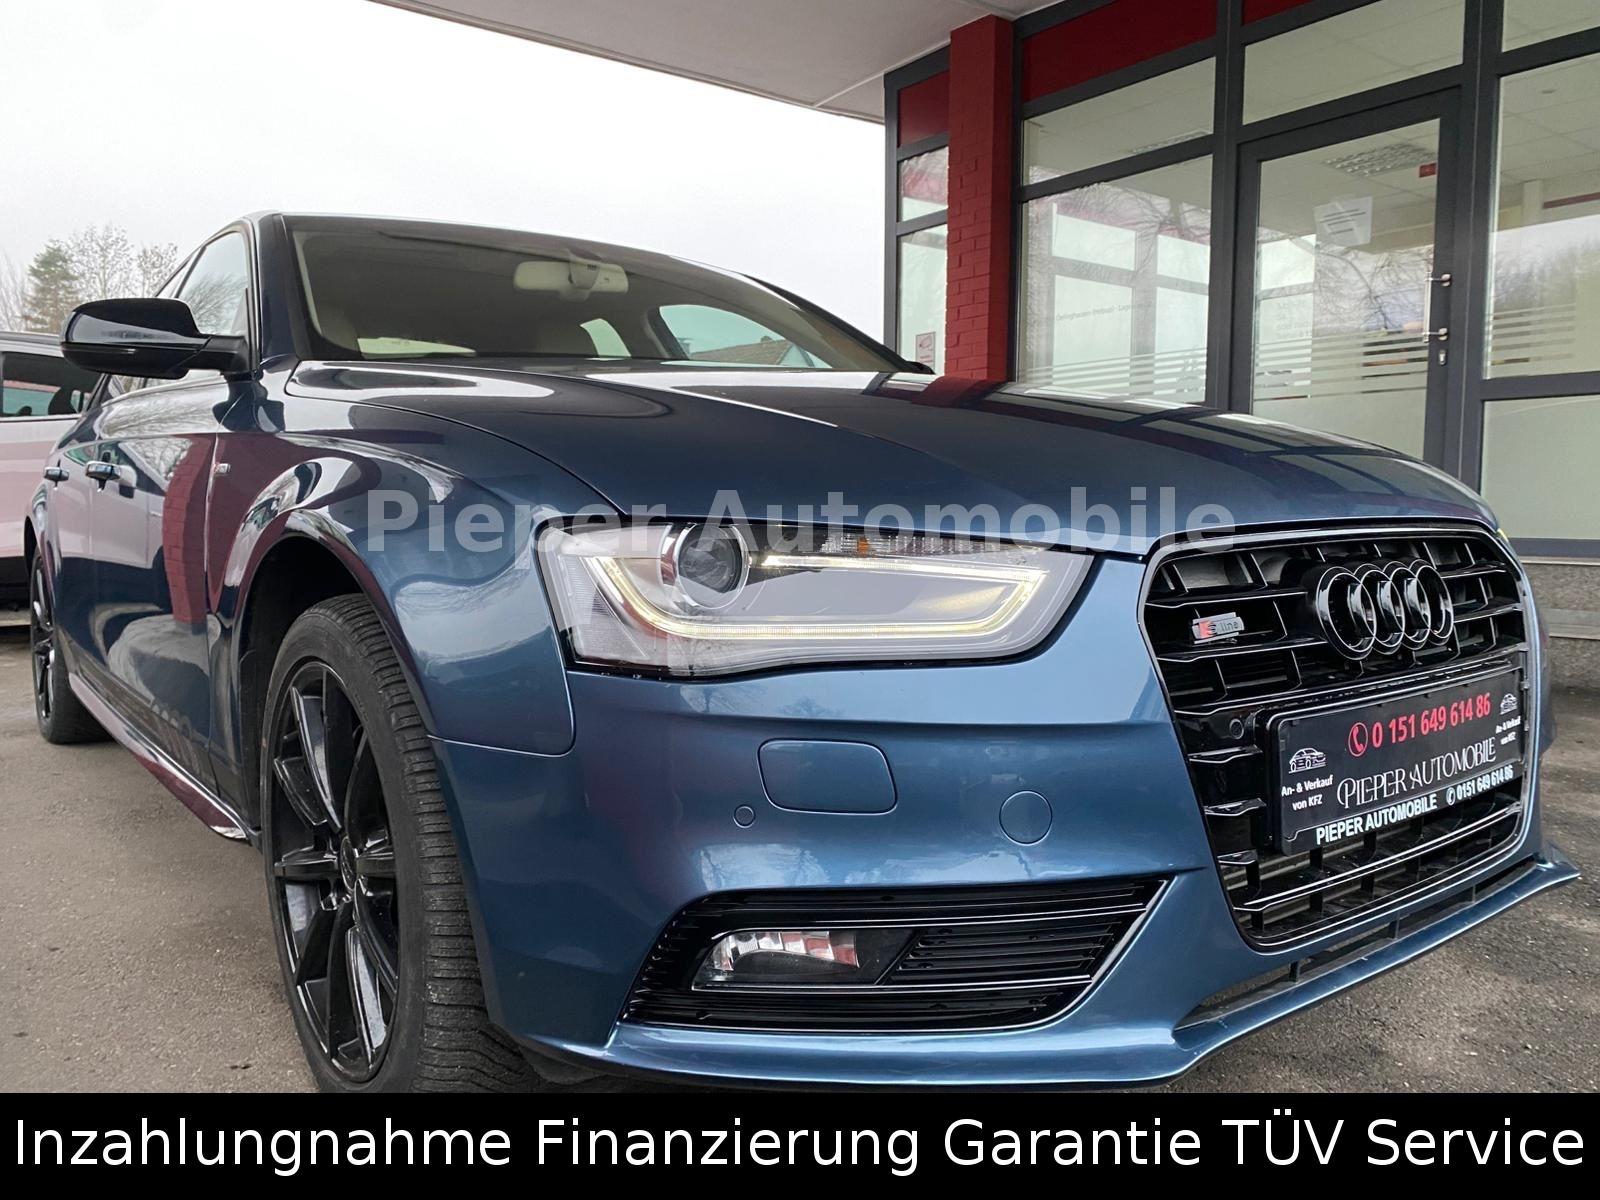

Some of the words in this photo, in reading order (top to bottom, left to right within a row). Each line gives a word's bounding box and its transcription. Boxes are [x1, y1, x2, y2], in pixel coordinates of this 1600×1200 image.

[1371, 721, 1384, 749] 0
[1388, 713, 1416, 744] 151
[1420, 705, 1447, 736] 649
[1450, 697, 1474, 727] 614
[1476, 692, 1491, 719] 86
[1303, 774, 1334, 792] Verkauf
[1336, 769, 1407, 809] PIEPER
[1410, 735, 1497, 789] AUTOMOBILE
[1291, 799, 1308, 811] von
[1308, 794, 1323, 808] KFZ
[1316, 817, 1364, 846] PIEPER
[1365, 793, 1438, 832] AUTOMOBILE
[1456, 782, 1477, 801] 0151
